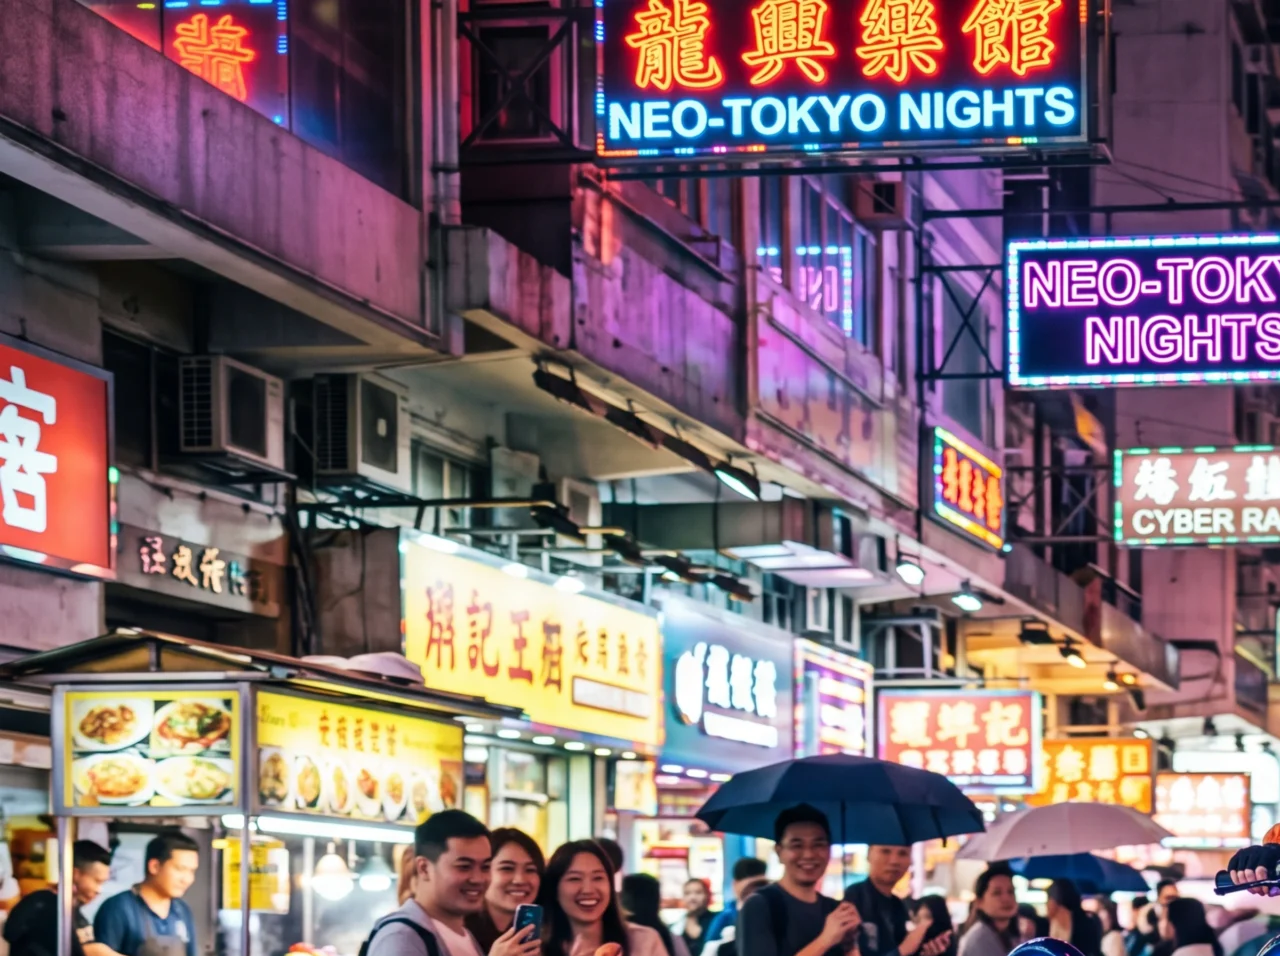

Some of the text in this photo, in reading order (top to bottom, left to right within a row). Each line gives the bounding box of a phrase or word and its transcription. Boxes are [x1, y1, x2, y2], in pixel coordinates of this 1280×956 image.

[608, 87, 1076, 140] NEO-TOKYO NIGHTS
[1132, 507, 1235, 534] CYBER
